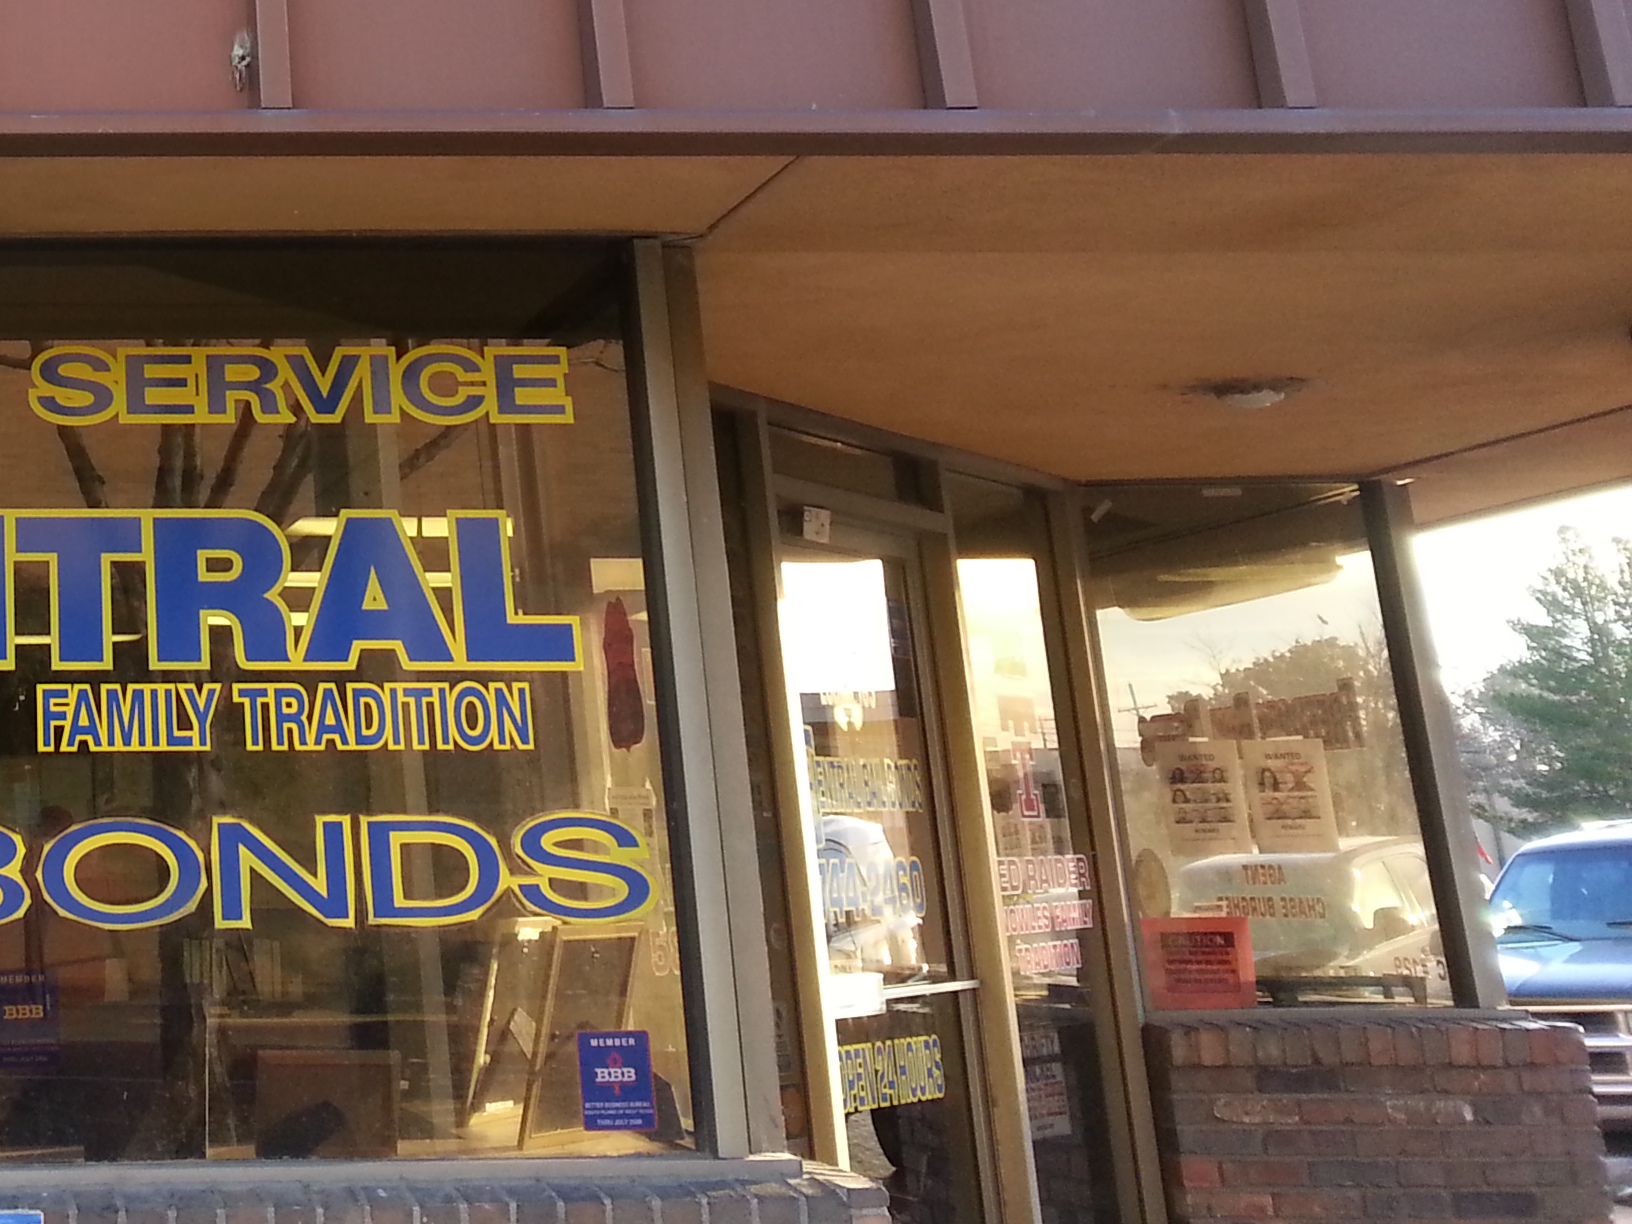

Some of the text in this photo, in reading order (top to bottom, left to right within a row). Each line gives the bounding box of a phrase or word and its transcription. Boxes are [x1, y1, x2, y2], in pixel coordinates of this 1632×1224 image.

[29, 345, 576, 426] SERVICE
[36, 680, 535, 753] FAMILY TRADITION
[1178, 753, 1215, 763] WANTED
[1264, 752, 1302, 762] WANTED
[996, 854, 1091, 895] ED RAIDER
[1167, 934, 1226, 946] CAUTION
[1015, 939, 1083, 976] TRADITION
[3, 1005, 44, 1019] BBB
[590, 1037, 636, 1047] MEMBER
[594, 1067, 637, 1082] BBB
[875, 1040, 899, 1108] 24
[893, 1033, 946, 1105] HOURS
